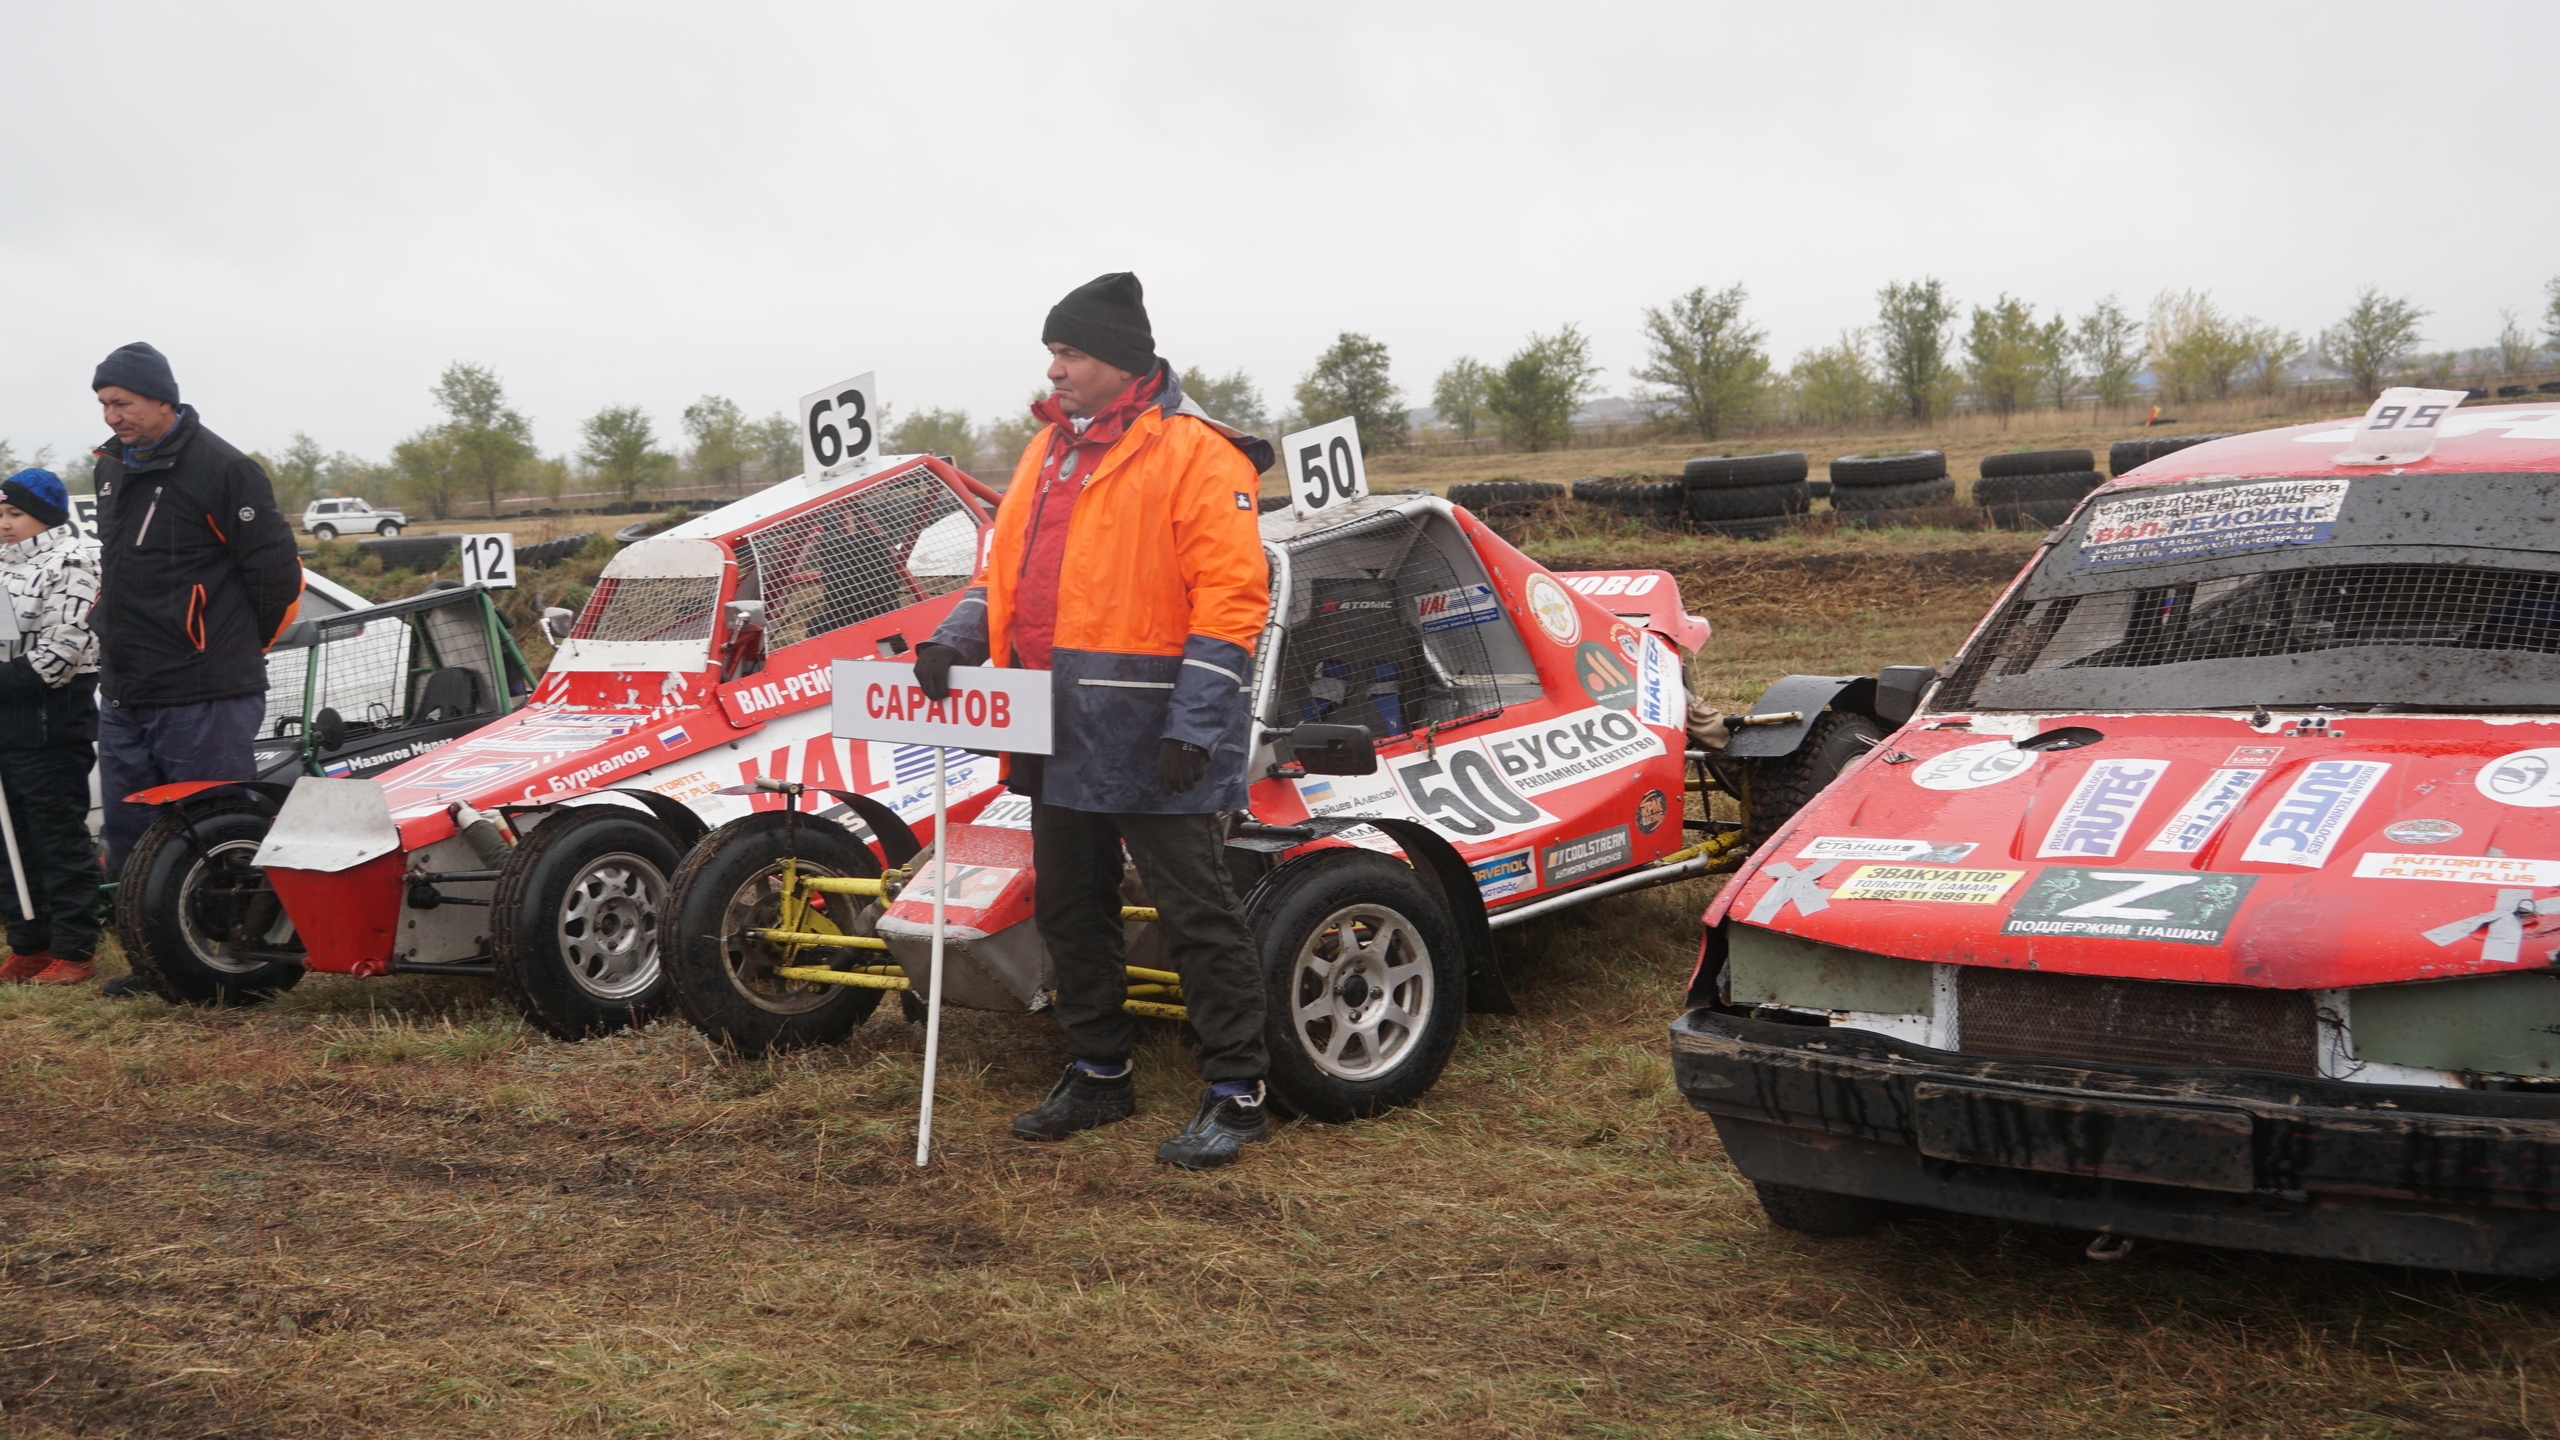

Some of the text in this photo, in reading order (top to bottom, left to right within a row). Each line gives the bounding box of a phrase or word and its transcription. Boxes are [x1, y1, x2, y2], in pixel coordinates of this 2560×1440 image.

[810, 388, 872, 468] 63
[1300, 436, 1356, 509] 50
[465, 537, 507, 580] 12
[1420, 594, 1447, 617] VAL
[1643, 634, 1661, 723] МАСТЕР
[866, 682, 1011, 729] САРАТОВ
[347, 747, 411, 772] Мазитов
[1491, 712, 1638, 777] БУСКО
[1515, 736, 1657, 790] РЕКЛАМНОЕ АГЕНТСТВО
[1920, 749, 1983, 781] LADA
[547, 744, 651, 794] Буркалов
[738, 732, 890, 813] VAL
[1398, 749, 1540, 836] 50
[1311, 786, 1399, 818] Зайцев Алексей
[2049, 765, 2110, 851] RUSSIAN TECHNOLOGIES
[2062, 765, 2157, 856] RUTEC
[2177, 770, 2259, 850] МАСТЕР
[2259, 762, 2365, 853] RUTEC
[2306, 765, 2378, 856] RUSSIAN TECHNOLOGIES
[1564, 831, 1627, 862] COOLSTREAM
[2158, 813, 2192, 845] СПОРТ
[1473, 859, 1526, 881] RAVENOL
[1854, 879, 1928, 890] ТОЛЬЯТТИ
[1938, 882, 1999, 892] САМАРА
[1867, 867, 2007, 883] ЭВАКУАТОР
[2379, 867, 2537, 883] PLAST PLUS
[1850, 889, 1990, 902] +7 963 11 999 11
[2056, 871, 2203, 921] Z
[2007, 919, 2219, 942] ПОДДЕРЖИМ НАШИХ!
